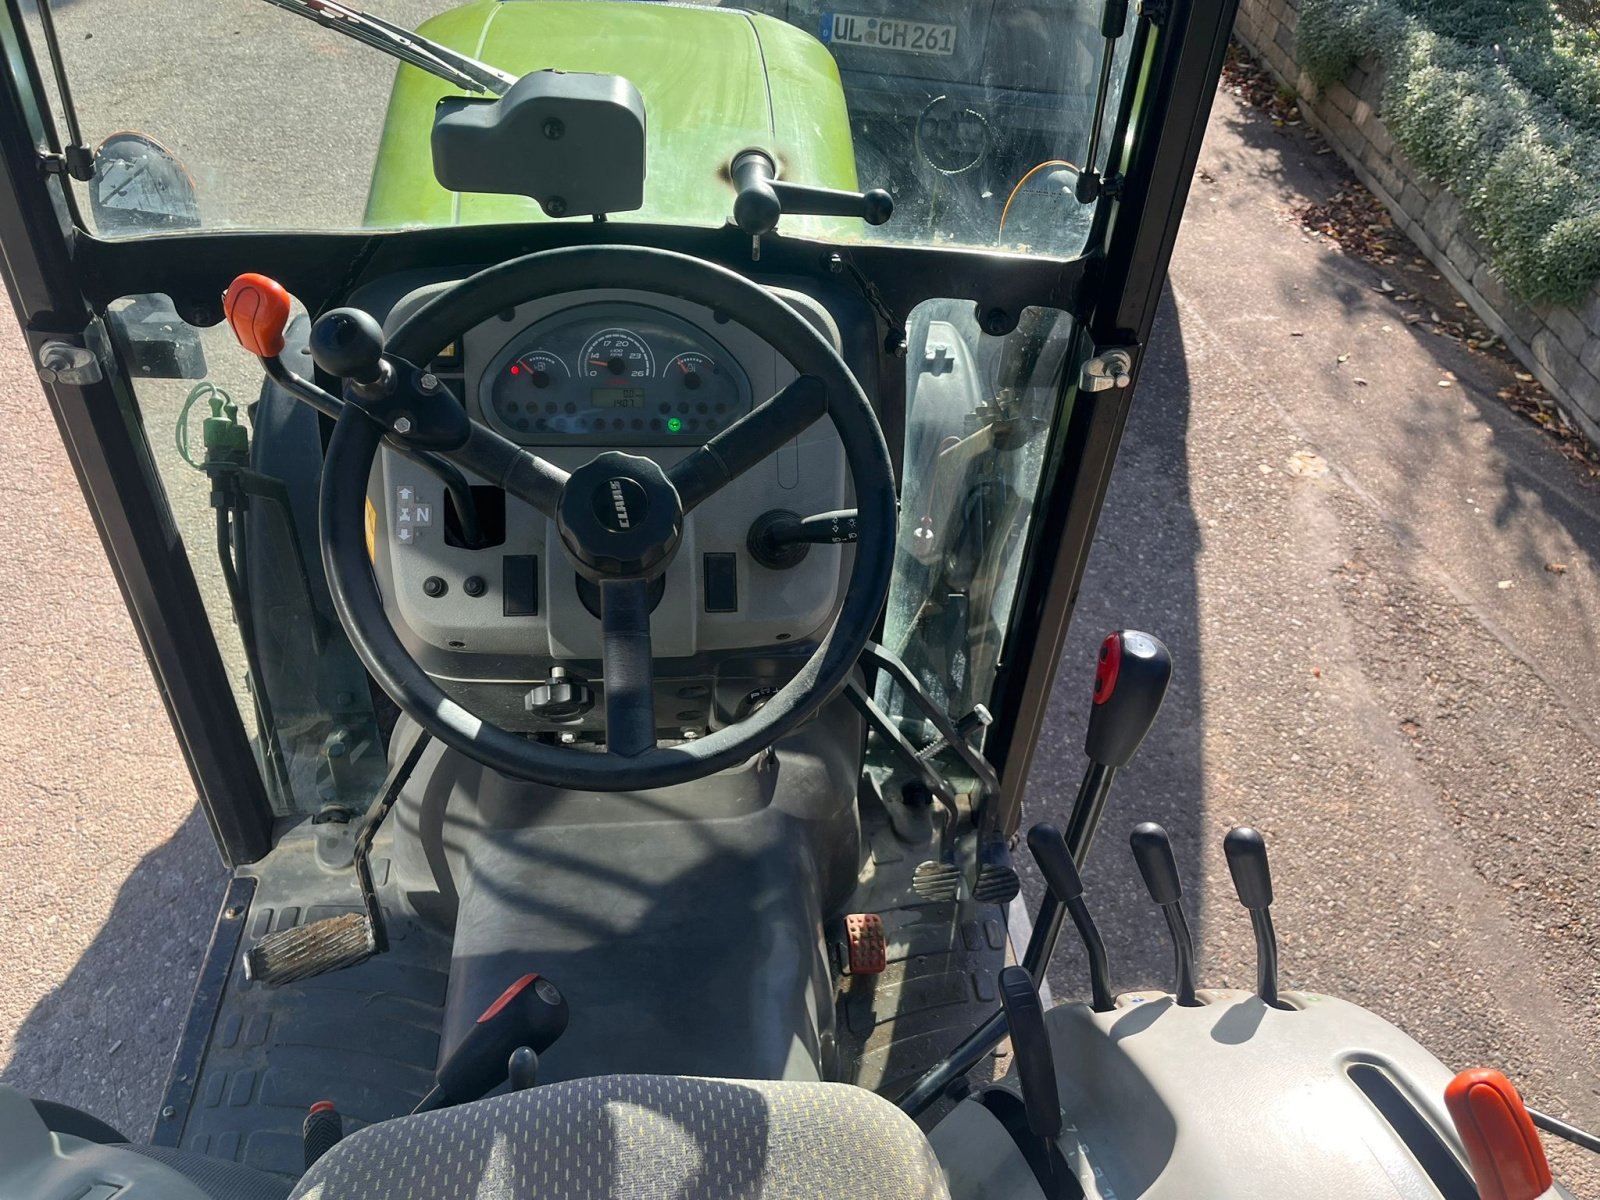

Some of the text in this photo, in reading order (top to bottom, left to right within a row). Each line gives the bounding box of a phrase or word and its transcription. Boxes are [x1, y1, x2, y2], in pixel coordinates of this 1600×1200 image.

[834, 16, 952, 52] UL CH 261
[416, 507, 430, 522] N
[609, 480, 631, 528] CLAAS
